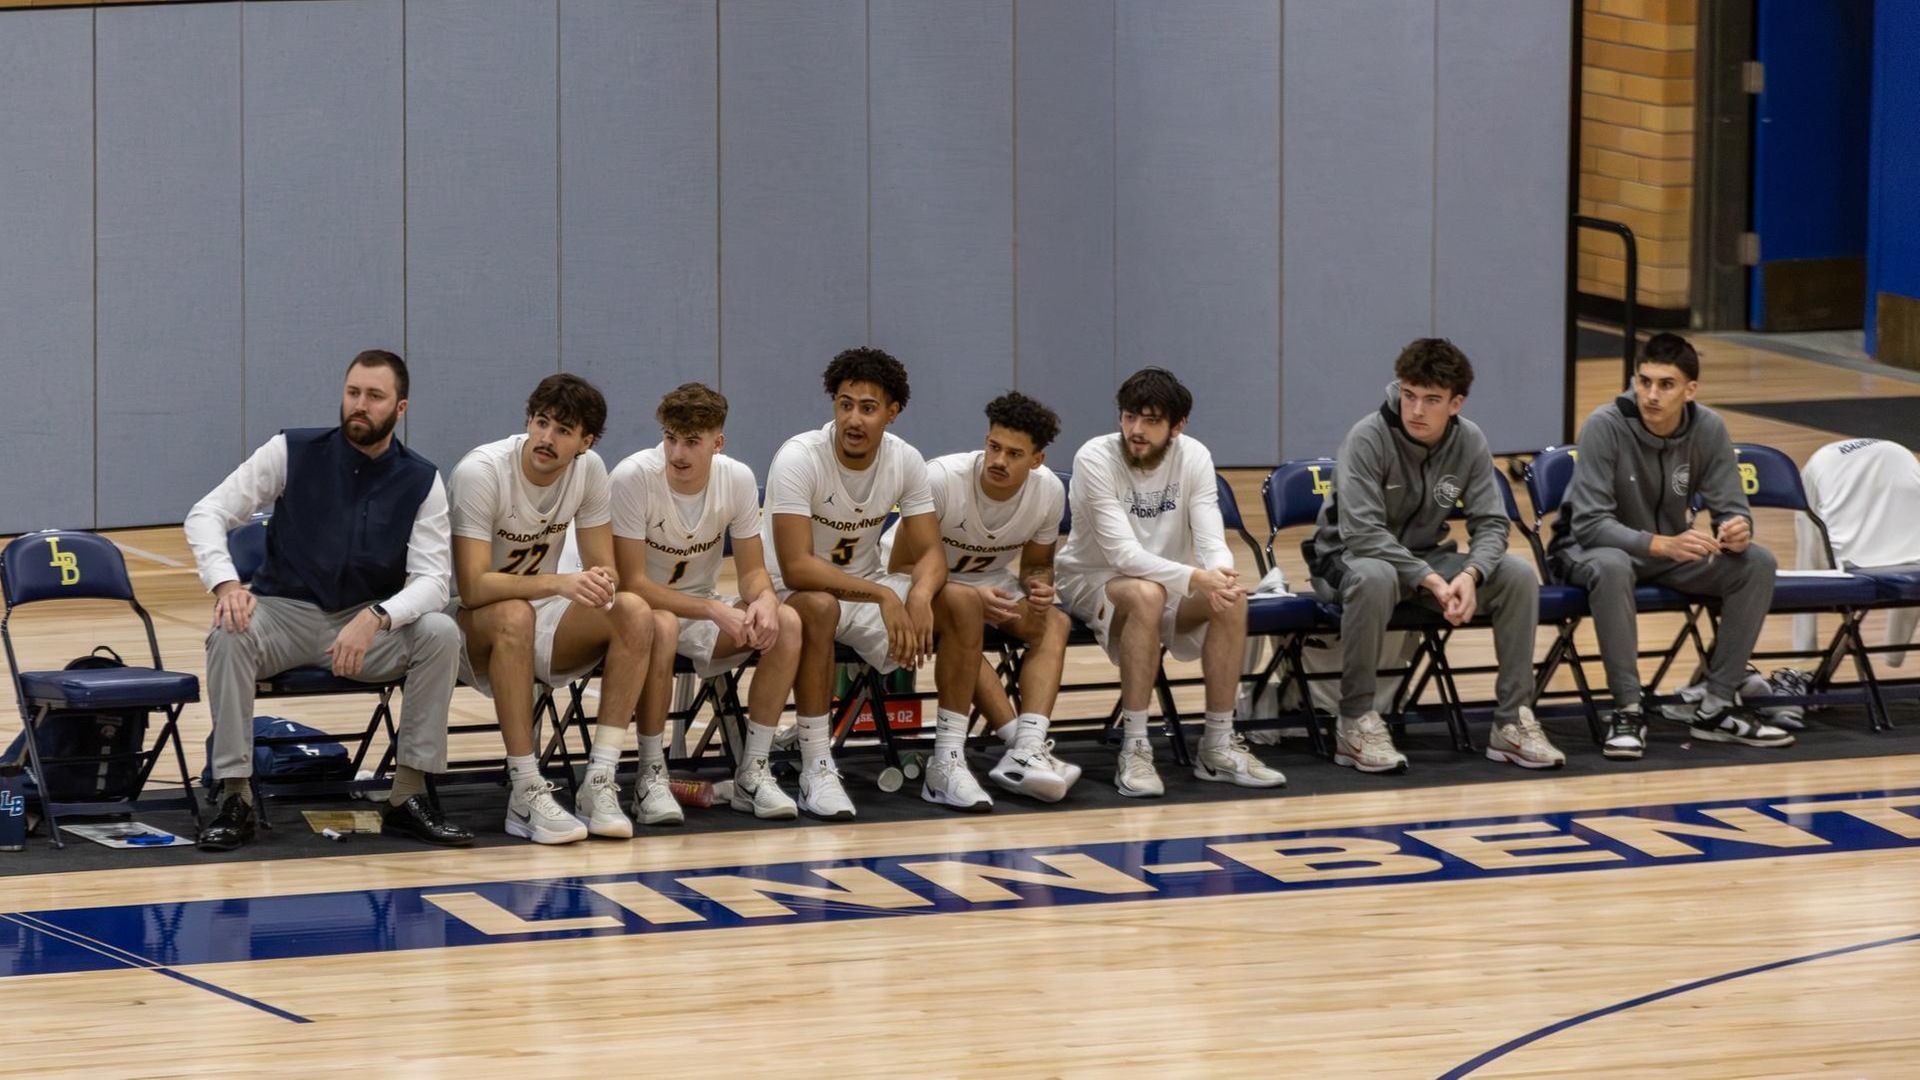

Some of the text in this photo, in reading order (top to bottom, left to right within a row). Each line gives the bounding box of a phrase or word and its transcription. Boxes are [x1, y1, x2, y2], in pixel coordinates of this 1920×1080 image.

[498, 543, 550, 576] 22
[830, 536, 861, 566] 5
[667, 560, 689, 585] 1
[949, 555, 997, 574] 12
[897, 710, 914, 724] 02
